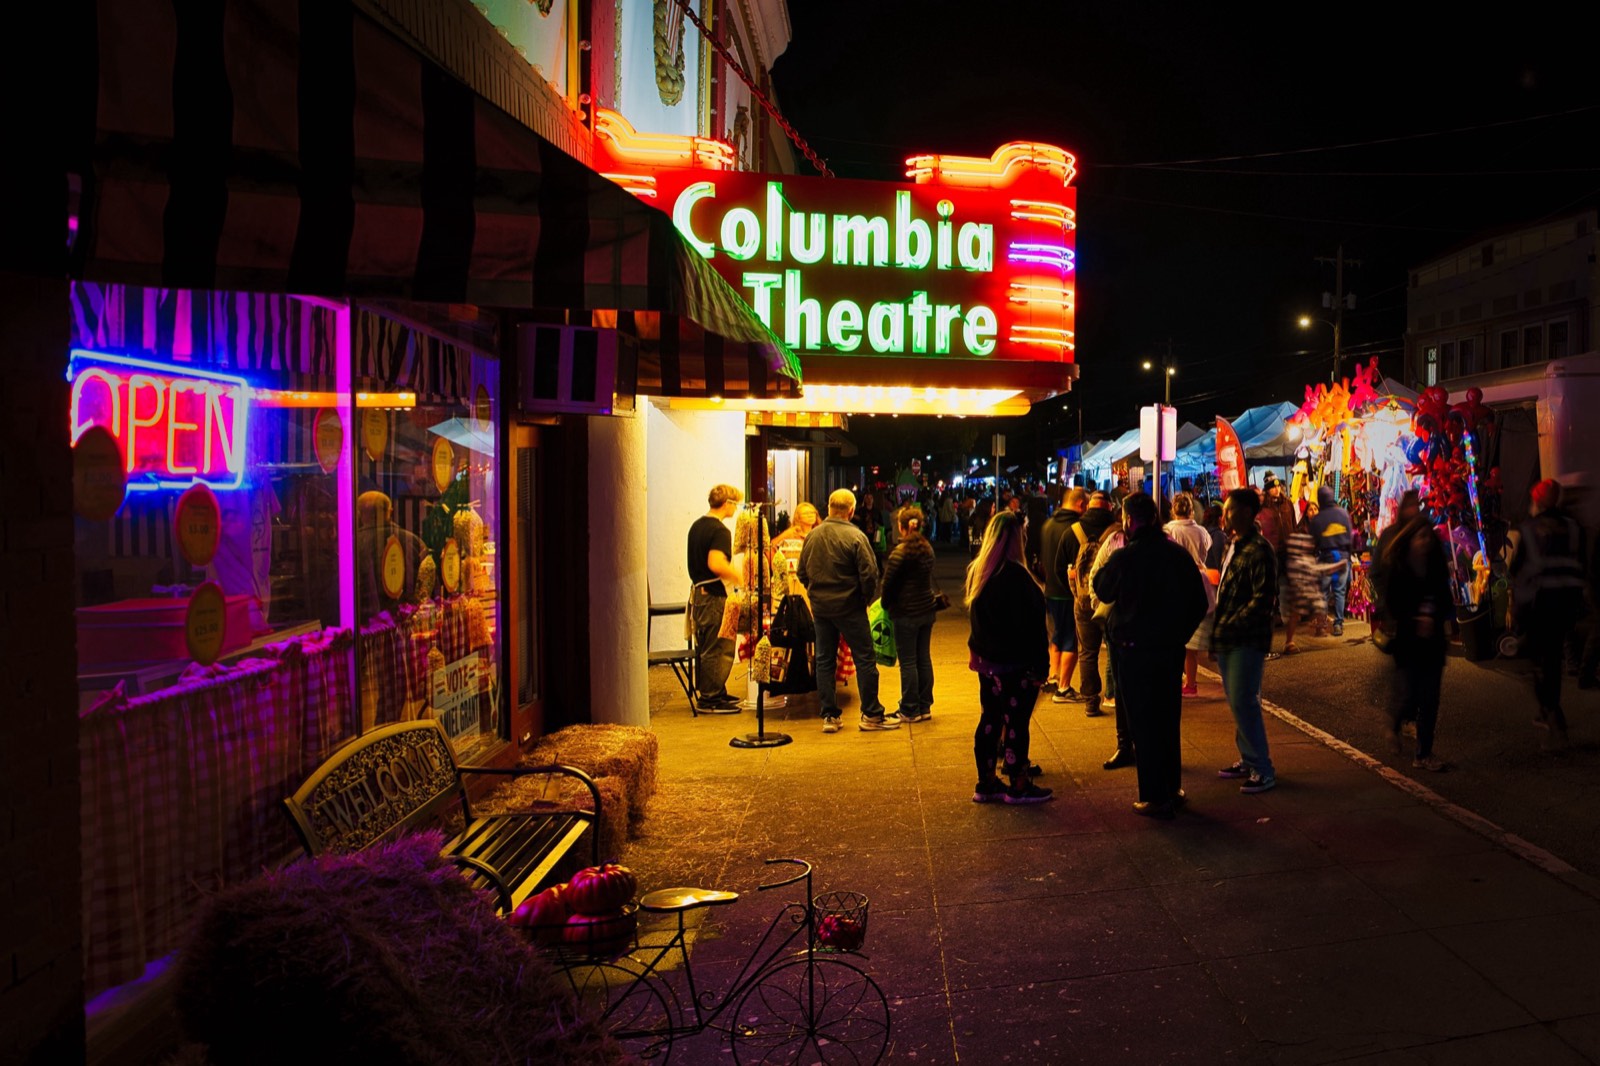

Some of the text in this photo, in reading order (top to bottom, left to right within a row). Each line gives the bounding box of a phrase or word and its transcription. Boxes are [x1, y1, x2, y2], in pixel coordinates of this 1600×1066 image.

[672, 181, 994, 273] Columbia
[742, 268, 998, 356] Theatre
[70, 367, 243, 474] OPEN
[446, 664, 469, 693] VOTE
[317, 737, 445, 837] WELCOME
